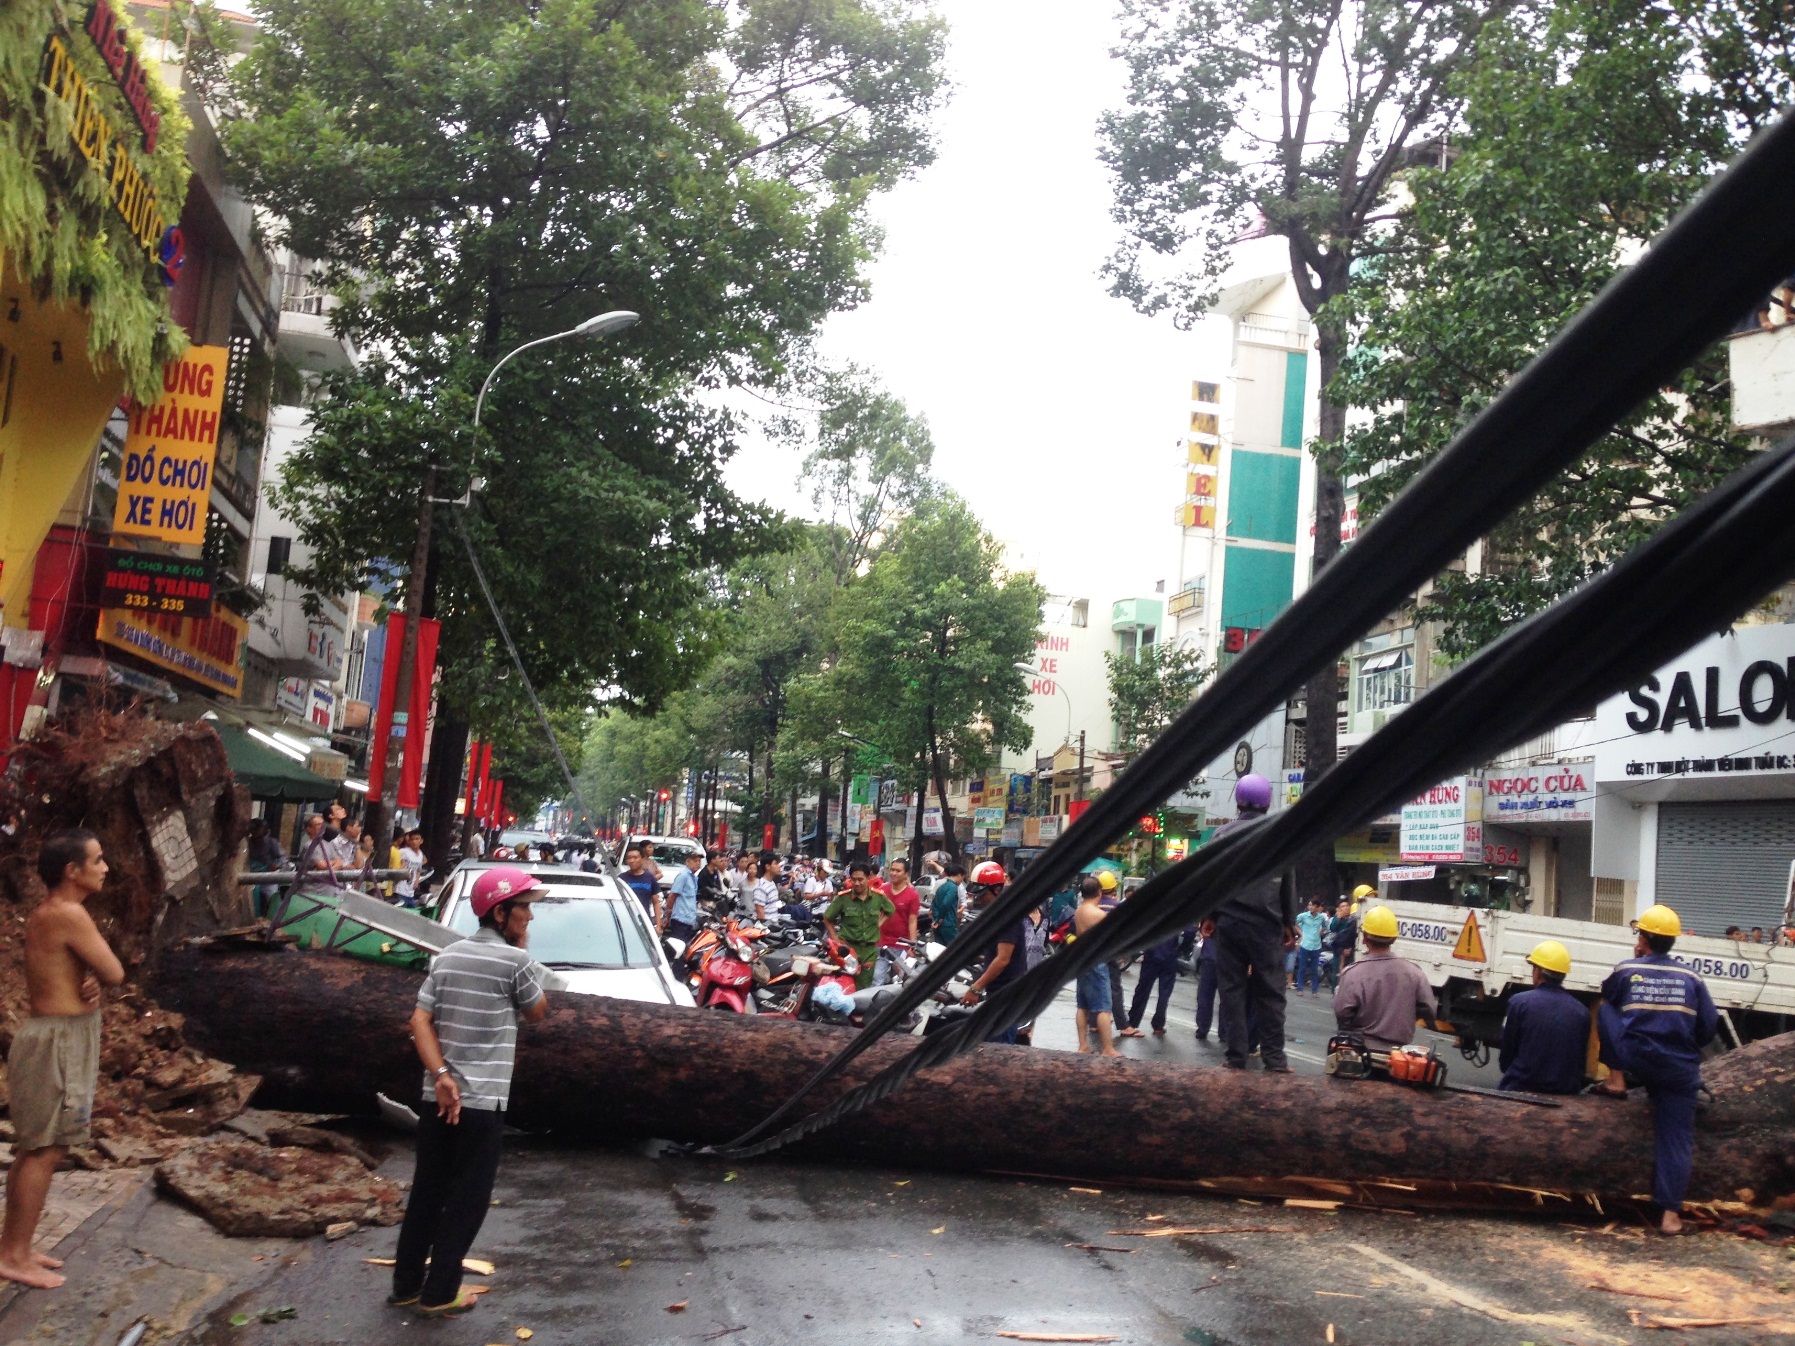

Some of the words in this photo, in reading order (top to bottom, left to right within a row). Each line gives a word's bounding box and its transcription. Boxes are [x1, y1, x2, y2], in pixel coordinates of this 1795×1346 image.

[163, 356, 215, 398] ƯNG
[132, 398, 218, 444] THÀNH
[158, 455, 209, 491] CHƠI
[124, 494, 155, 526] XE
[158, 495, 197, 531] HƠI
[124, 593, 149, 607] 333
[1040, 657, 1058, 673] XE
[1487, 776, 1539, 798] NGỌC
[1544, 767, 1587, 793] CỦA
[1645, 762, 1655, 775] TY
[1483, 843, 1520, 865] 354
